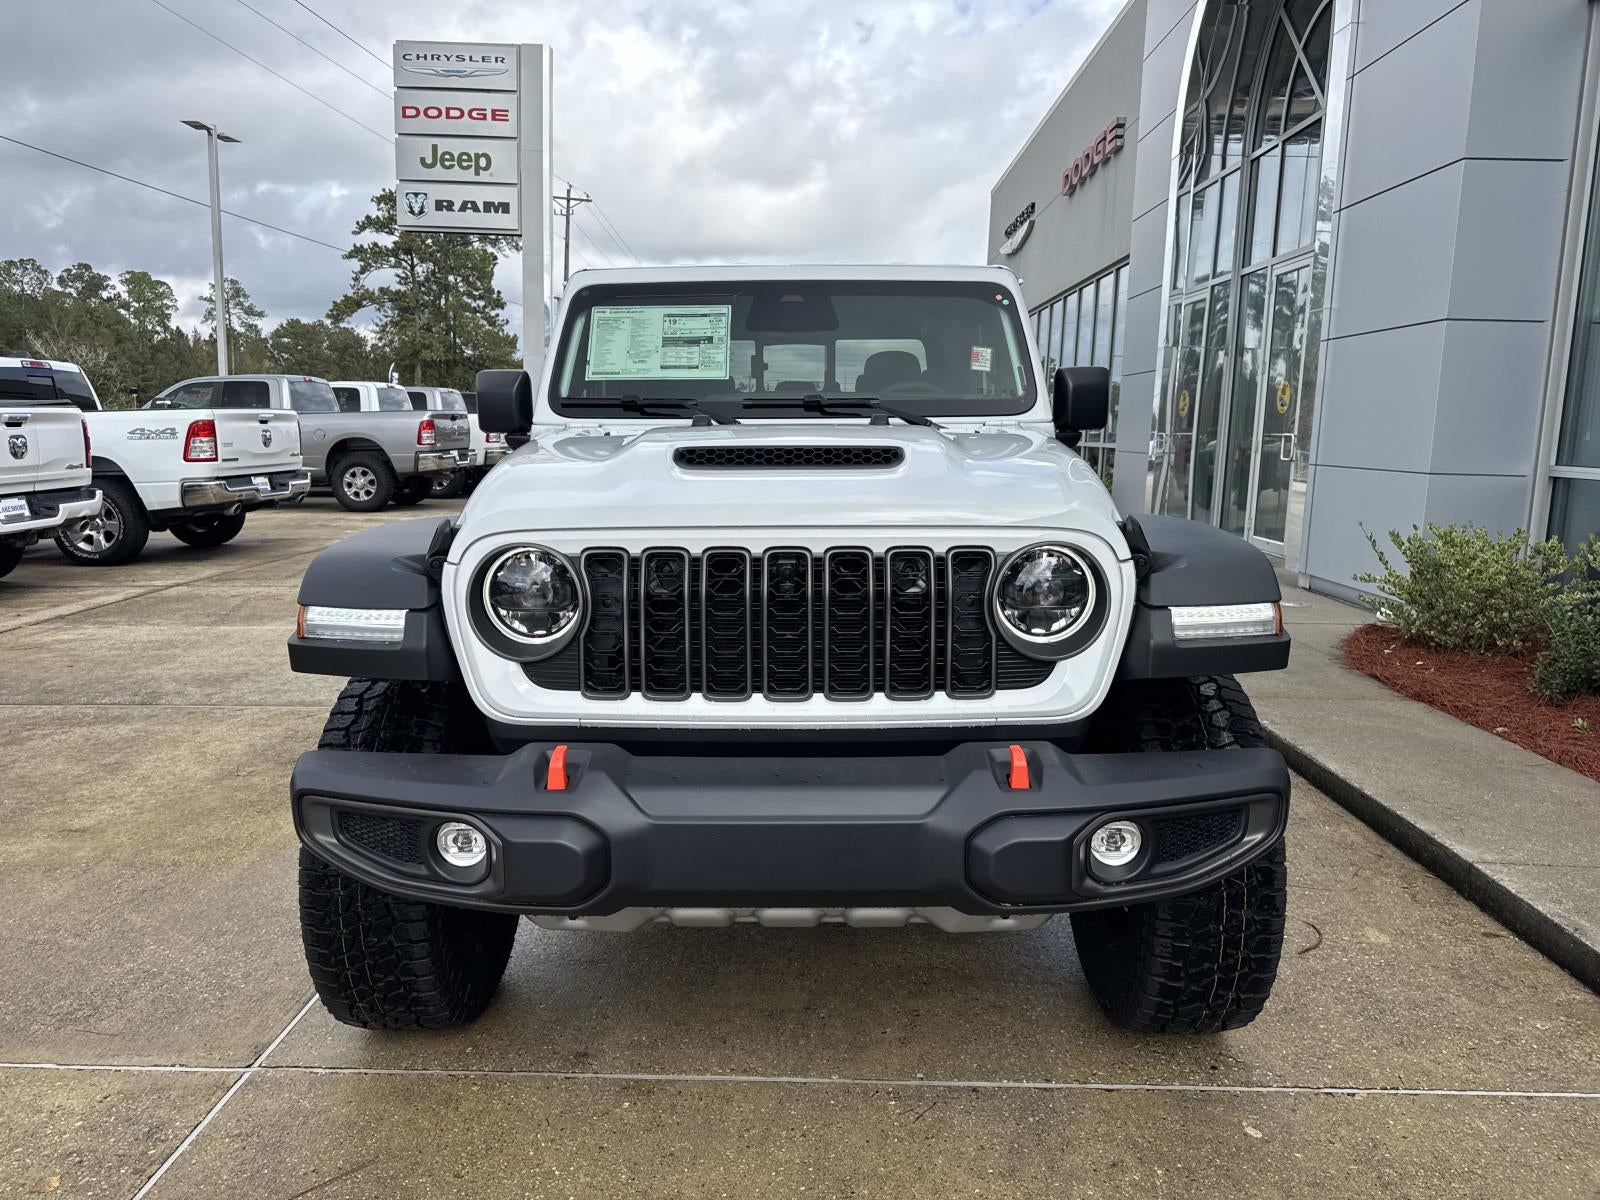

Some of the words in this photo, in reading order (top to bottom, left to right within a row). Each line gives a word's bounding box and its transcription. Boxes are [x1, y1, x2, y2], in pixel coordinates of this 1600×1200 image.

[402, 53, 507, 64] CHRYSLER
[401, 105, 510, 122] DODGE
[419, 143, 492, 176] Jeep
[1062, 116, 1127, 196] DODGE
[434, 199, 511, 215] RAM
